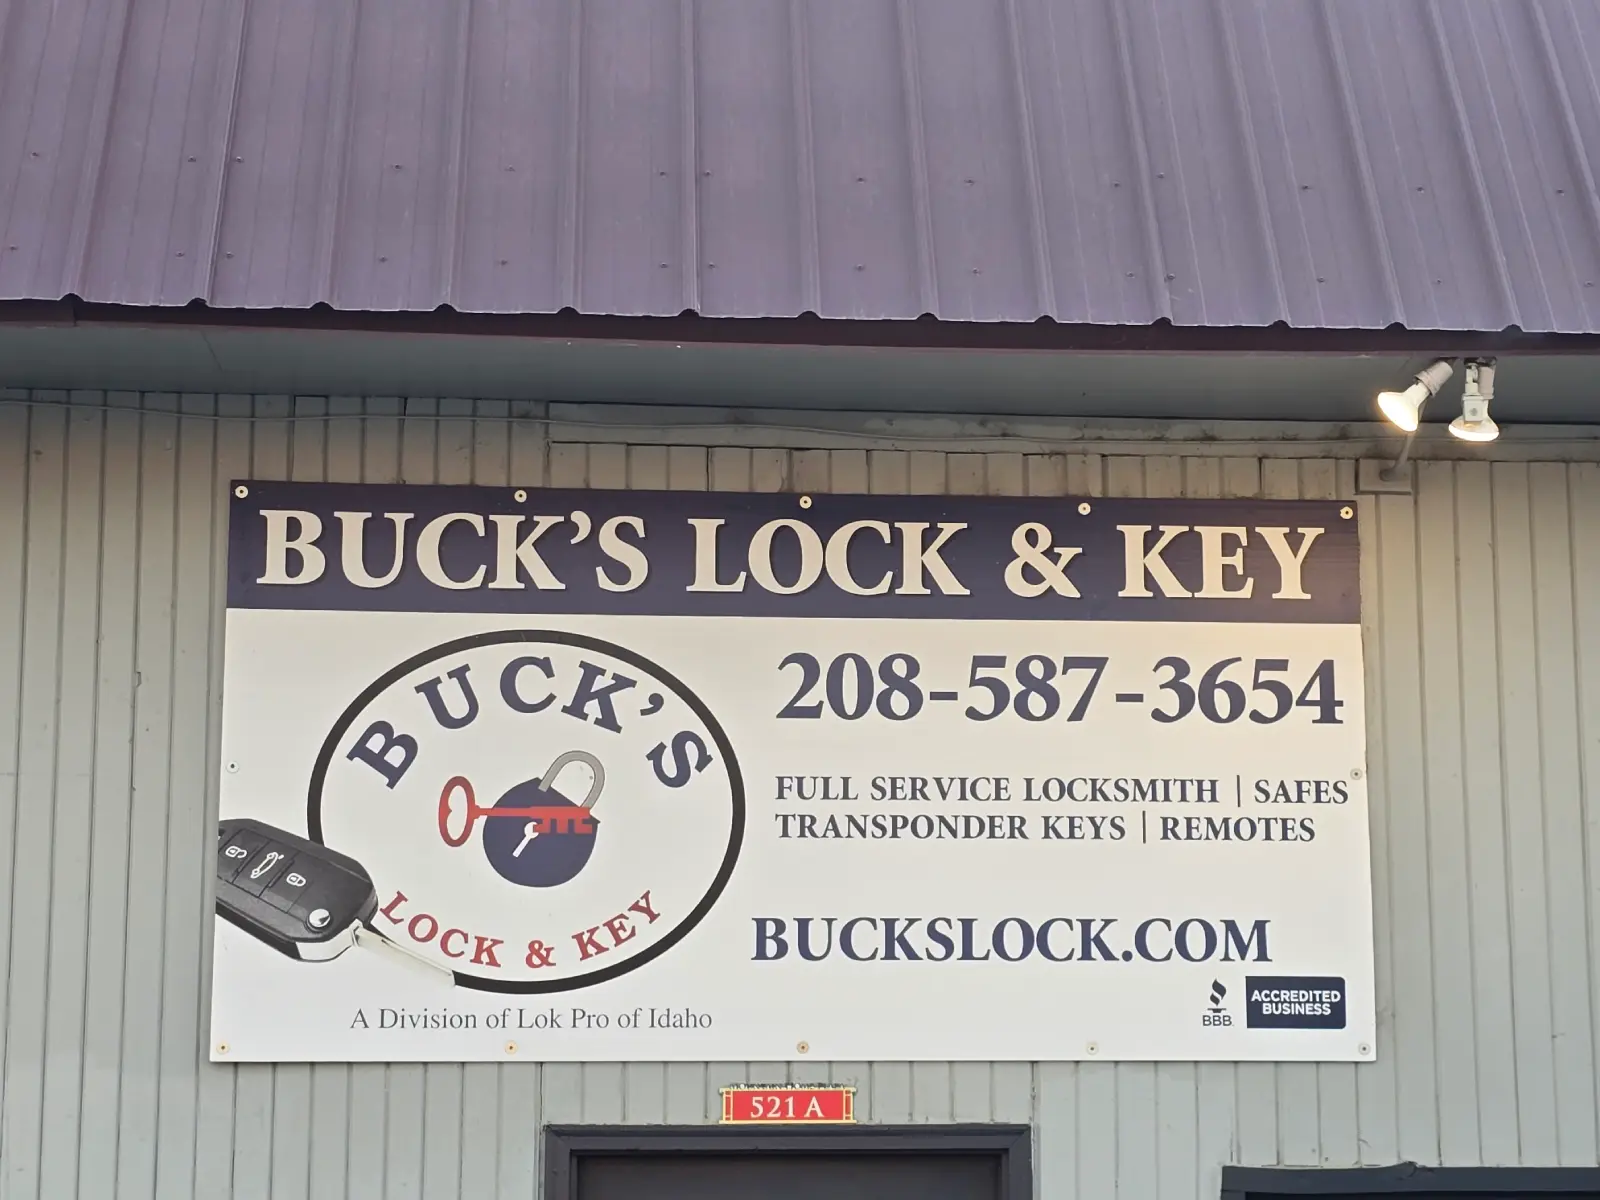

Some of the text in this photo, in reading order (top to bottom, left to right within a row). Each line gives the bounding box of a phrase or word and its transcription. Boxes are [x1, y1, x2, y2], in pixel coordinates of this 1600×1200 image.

[256, 509, 1325, 600] BUCK'S LOCK & KEY
[775, 652, 1344, 725] 208-587-3654
[345, 656, 714, 790] BUCK'S
[775, 775, 859, 801] FULL
[870, 776, 1012, 802] SERVICE
[1023, 777, 1220, 804] LOCKSMITH
[1254, 779, 1349, 805] SAFES
[774, 813, 1030, 841] TRANSPONDER
[1040, 815, 1126, 842] KEYS
[1159, 816, 1316, 843] REMOTES
[380, 890, 662, 969] LOCK & KEY
[750, 916, 1273, 963] BUCKSLOCK.COM
[1251, 989, 1342, 1003] ACCREDITED
[1262, 1002, 1332, 1016] BUSINESS
[350, 1007, 713, 1029] A Division of Lok Pro of Idaho
[1202, 1014, 1233, 1027] BBB
[750, 1096, 825, 1118] 521 A
